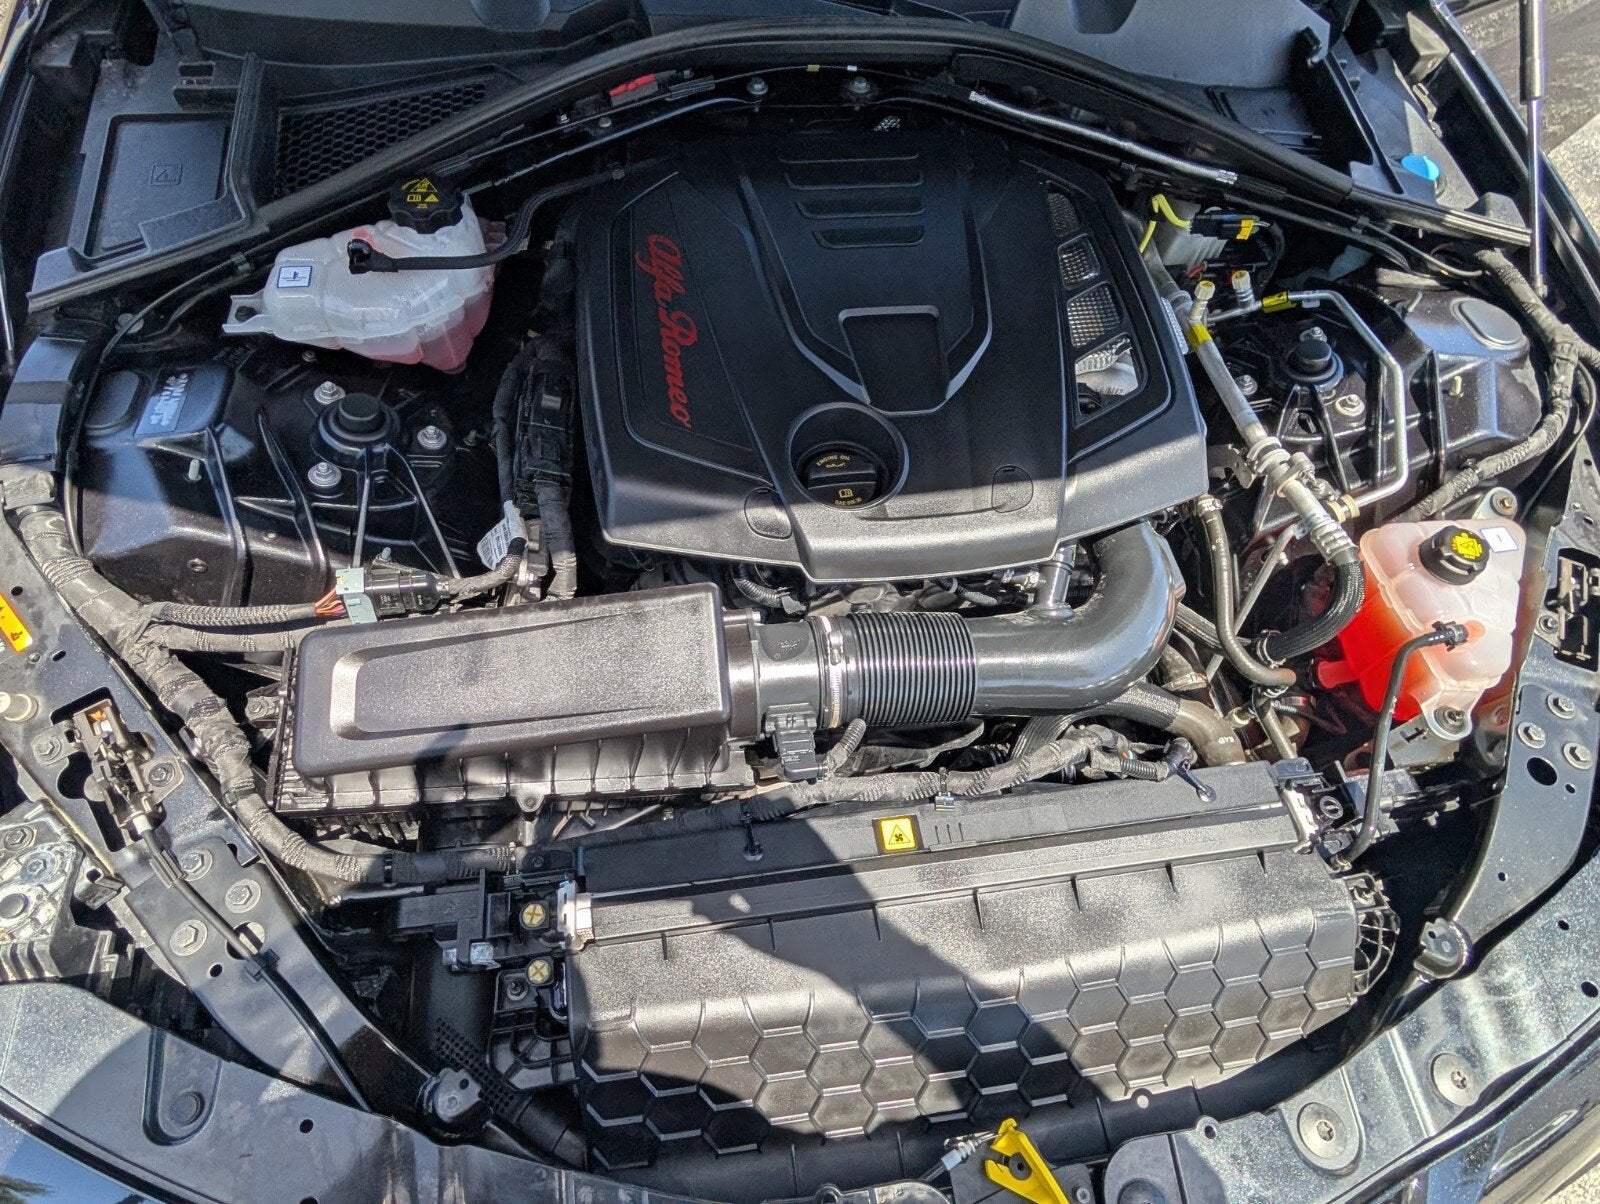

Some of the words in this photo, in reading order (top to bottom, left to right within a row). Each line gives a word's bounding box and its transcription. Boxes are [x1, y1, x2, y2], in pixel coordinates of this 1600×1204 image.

[634, 235, 686, 307] Alfa
[658, 306, 698, 429] Romeo
[816, 454, 838, 466] ENGINE
